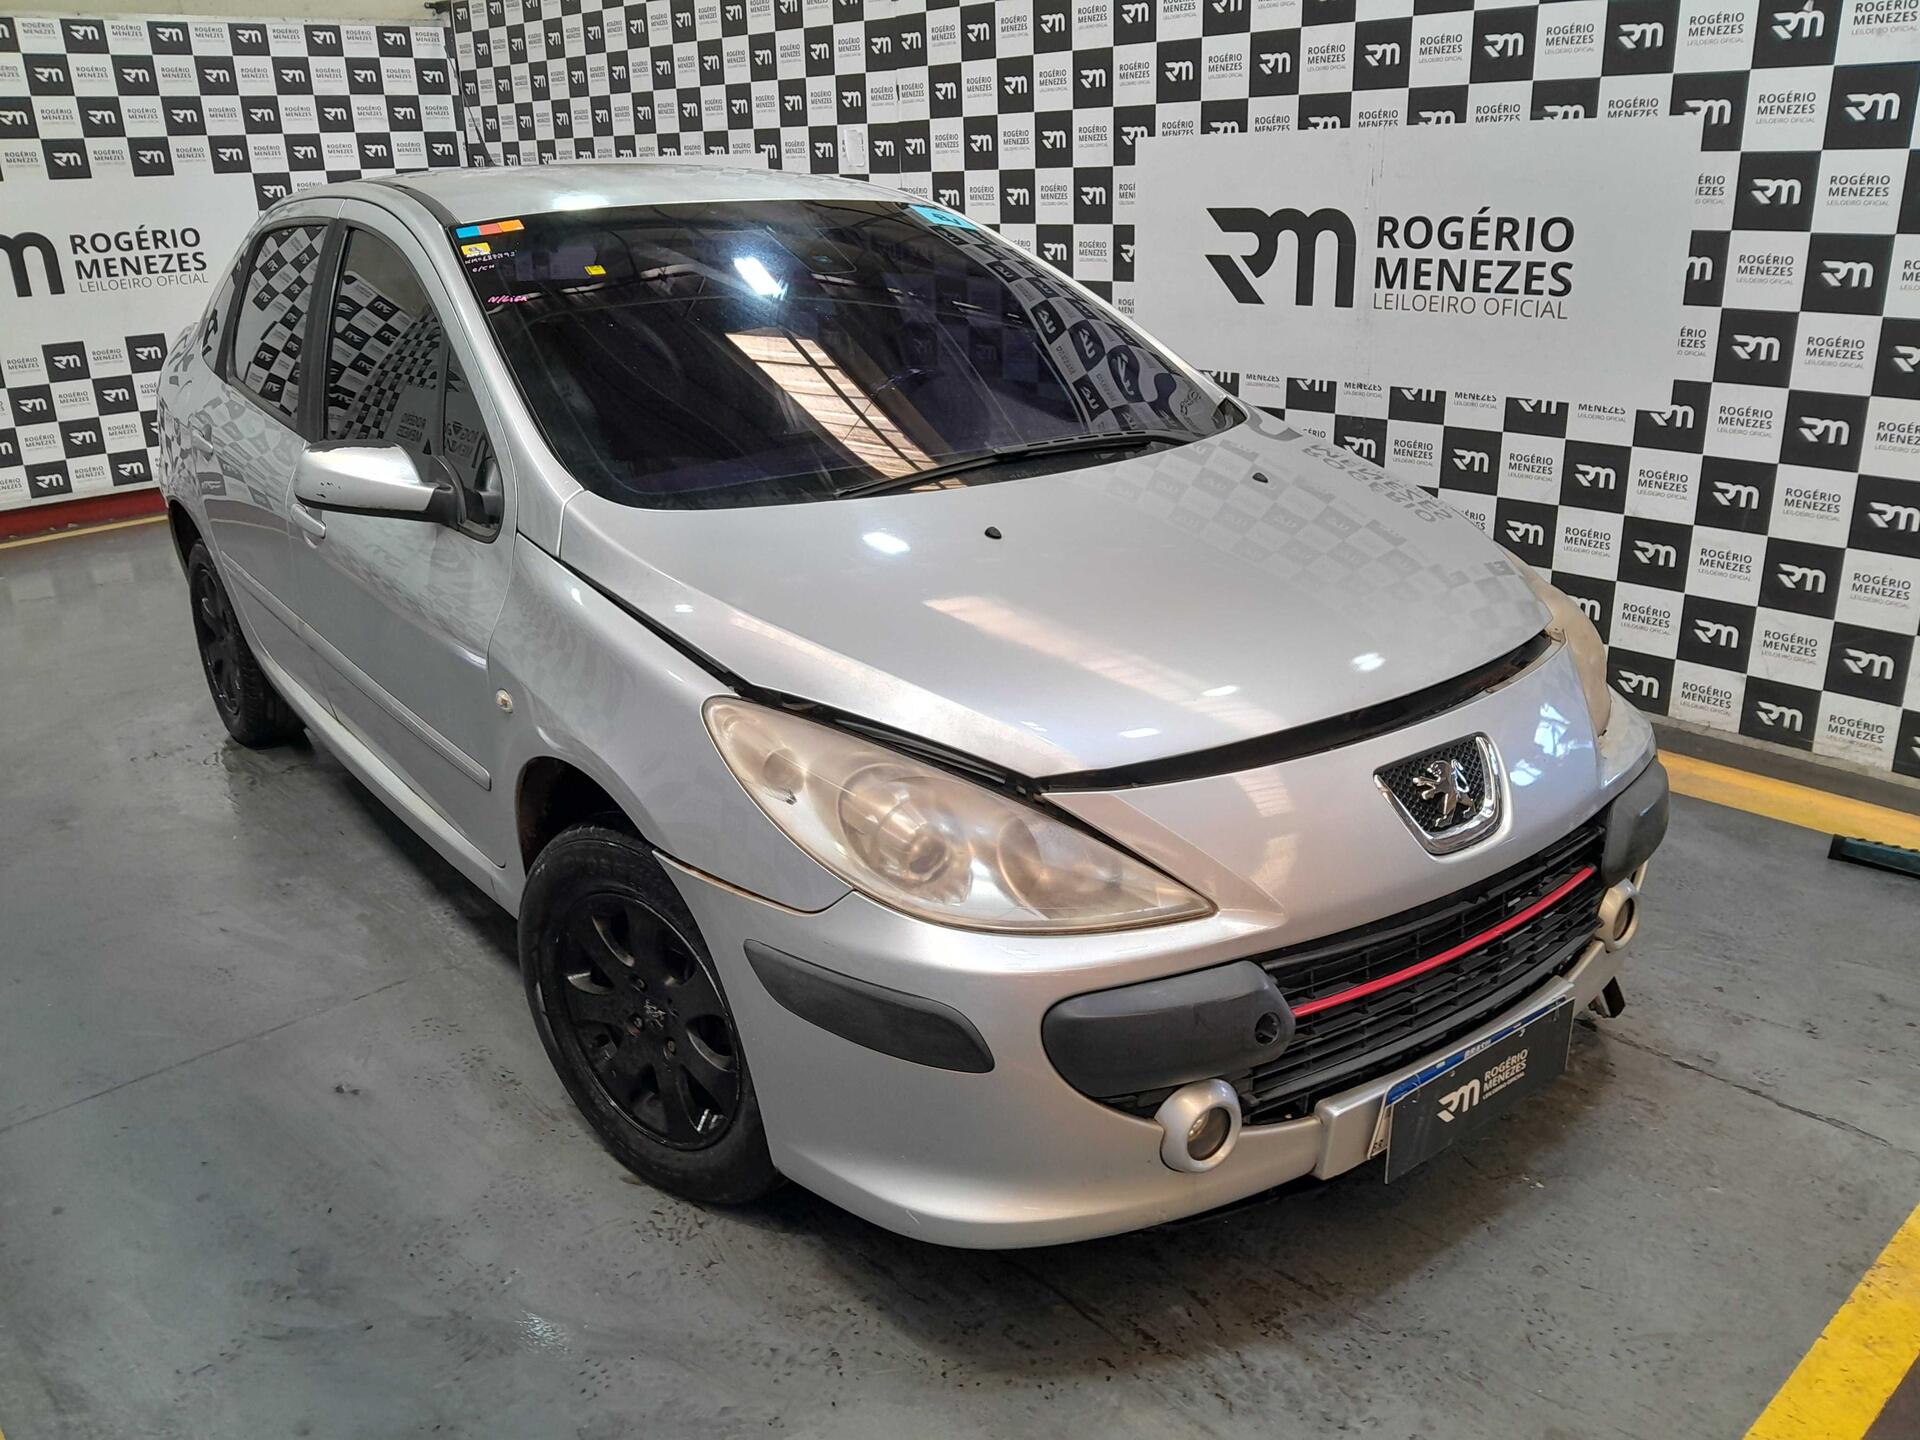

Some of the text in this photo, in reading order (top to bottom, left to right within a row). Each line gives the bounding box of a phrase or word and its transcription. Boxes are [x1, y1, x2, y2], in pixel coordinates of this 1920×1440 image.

[1077, 2, 1107, 14] ROGÉRIO
[1000, 13, 1027, 24] ROGÉRIO
[1077, 11, 1107, 23] MENEZES
[1688, 9, 1745, 25] ROGÉRIO
[1852, 9, 1919, 25] MENEZES
[1000, 21, 1028, 32] MENEZES
[1545, 21, 1594, 36] ROGÉRIO
[1687, 22, 1745, 37] MENEZES
[1419, 32, 1462, 46] ROGÉRIO
[1544, 33, 1594, 47] MENEZES
[1307, 42, 1346, 55] ROGÉRIO
[1418, 44, 1462, 56] MENEZES
[1208, 51, 1242, 63] ROGÉRIO
[1307, 53, 1346, 64] MENEZES
[1119, 59, 1150, 71] ROGÉRIO
[1208, 61, 1243, 72] MENEZES
[966, 74, 991, 85] ROGÉRIO
[1039, 67, 1067, 78] ROGÉRIO
[1119, 69, 1150, 79] MENEZES
[966, 83, 992, 93] MENEZES
[1039, 76, 1067, 86] MENEZES
[1607, 95, 1659, 109] ROGÉRIO
[1758, 88, 1817, 104] ROGÉRIO
[1358, 107, 1398, 120] ROGÉRIO
[1475, 102, 1520, 115] ROGÉRIO
[1756, 102, 1816, 115] MENEZES
[1255, 113, 1290, 124] ROGÉRIO
[1002, 127, 1029, 138] ROGÉRIO
[1078, 123, 1107, 133] ROGÉRIO
[1003, 136, 1029, 145] MENEZES
[1078, 132, 1108, 141] MENEZES
[1829, 171, 1892, 185] ROGÉRIO
[1040, 182, 1068, 192] ROGÉRIO
[1828, 186, 1891, 196] MENEZES
[1040, 191, 1068, 199] MENEZES
[1377, 206, 1574, 252] ROGÉRIO
[70, 225, 200, 254] ROGÉRIO
[1079, 238, 1107, 248] ROGÉRIO
[1079, 247, 1108, 255] MENEZES
[75, 252, 207, 280] MENEZES
[1737, 252, 1794, 266] ROGÉRIO
[1374, 257, 1573, 297] MENEZES
[1736, 265, 1794, 276] MENEZES
[79, 273, 208, 292] LEILOEIRO OFICIAL
[1373, 293, 1568, 320] LEILOEIRO OFICIAL
[1806, 334, 1866, 349] ROGÉRIO
[1804, 346, 1865, 360] MENEZES
[1718, 405, 1773, 420] ROGÉRIO
[1716, 415, 1772, 430] MENEZES
[1395, 438, 1434, 451] ROGÉRIO
[1394, 446, 1434, 460] MENEZES
[1509, 452, 1554, 466] ROGÉRIO
[1508, 461, 1553, 475] MENEZES
[1638, 468, 1688, 483] ROGÉRIO
[1637, 478, 1688, 493] MENEZES
[1784, 486, 1842, 503] ROGÉRIO
[1782, 497, 1841, 514] MENEZES
[1565, 526, 1611, 541] ROGÉRIO
[1564, 535, 1611, 550] MENEZES
[1699, 547, 1752, 564] ROGÉRIO
[1698, 556, 1752, 574] MENEZES
[1852, 571, 1913, 590] ROGÉRIO
[1851, 581, 1912, 600] MENEZES
[1622, 602, 1671, 619] ROGÉRIO
[1621, 611, 1670, 629] MENEZES
[1763, 628, 1818, 648] ROGÉRIO
[1761, 638, 1817, 657] MENEZES
[1681, 681, 1732, 700] ROGÉRIO
[1680, 690, 1732, 709] MENEZES
[1828, 713, 1887, 734] ROGÉRIO
[1827, 722, 1886, 744] MENEZES
[1484, 1048, 1528, 1080] ROGÉRIO
[1484, 1059, 1526, 1092] MENEZES
